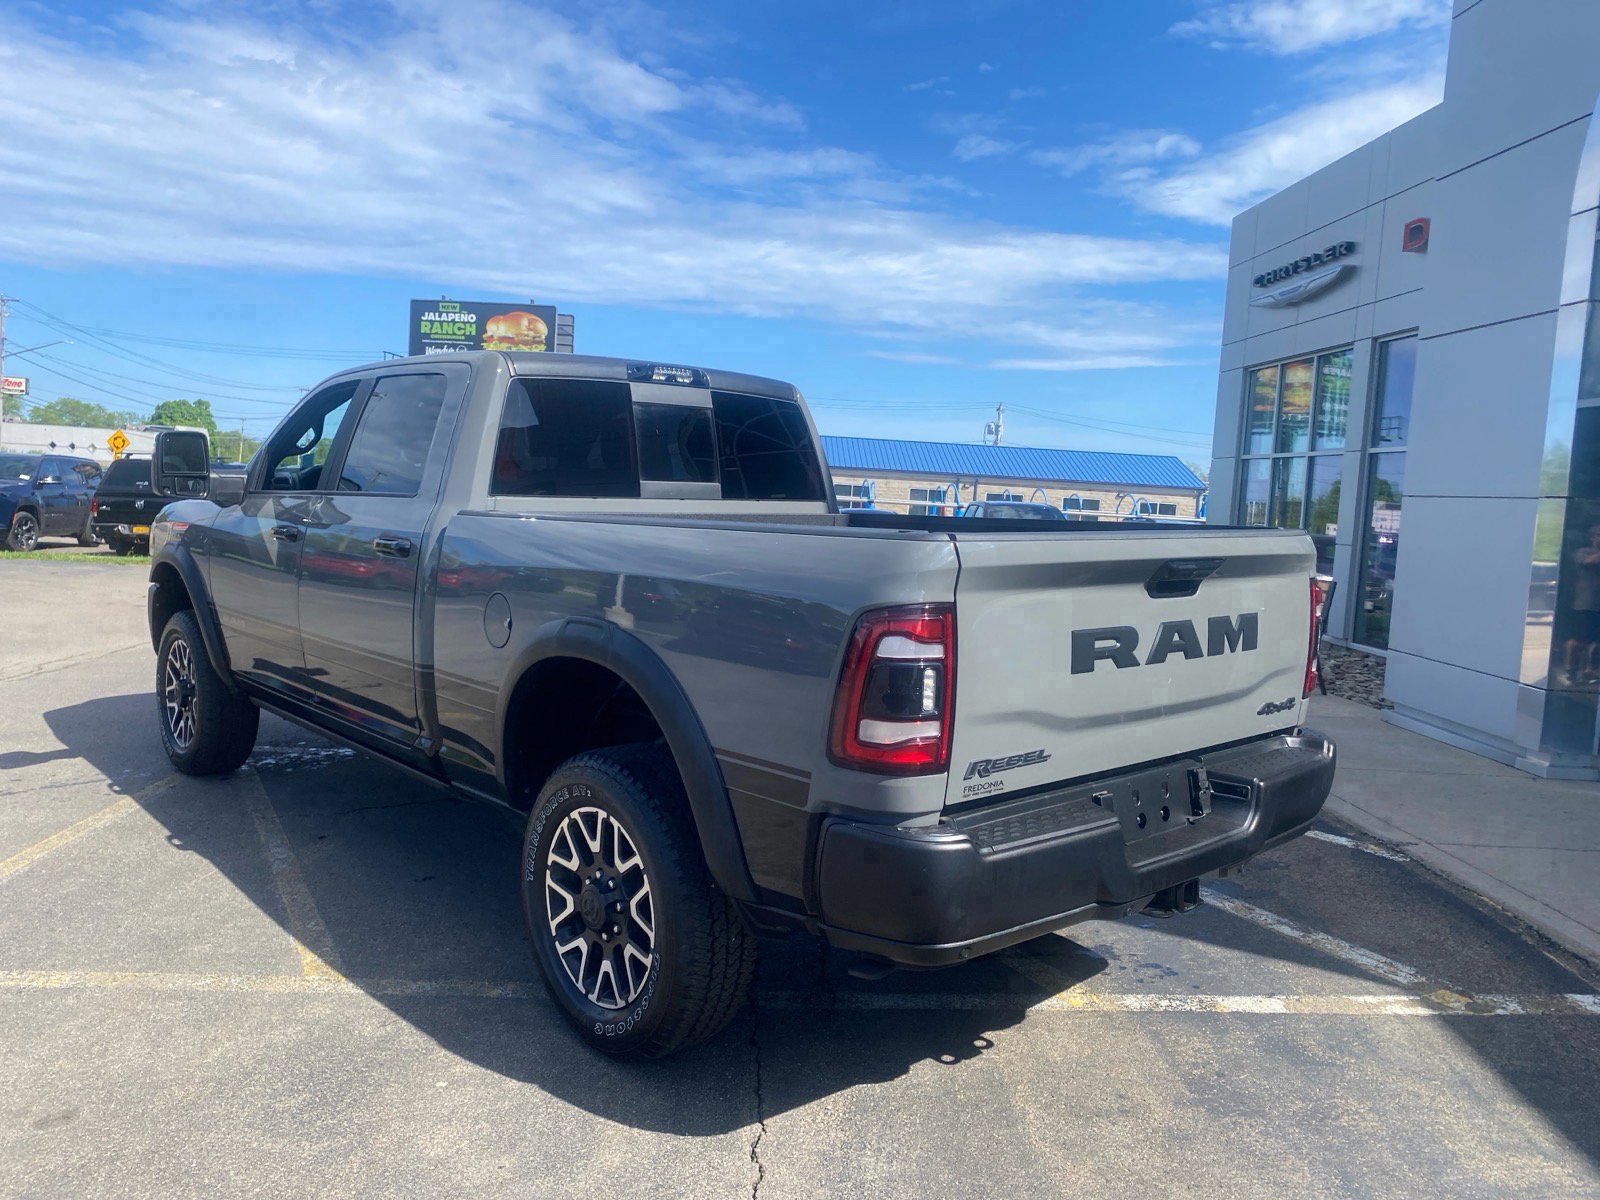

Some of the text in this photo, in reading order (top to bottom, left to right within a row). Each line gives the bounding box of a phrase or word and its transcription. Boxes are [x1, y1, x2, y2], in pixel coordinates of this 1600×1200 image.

[1253, 240, 1356, 288] CHRYSLER
[421, 311, 476, 322] JALAPEÑO
[421, 322, 476, 335] RANCH
[1071, 612, 1258, 675] RAM
[1257, 696, 1296, 715] 4x4
[963, 749, 1052, 781] REBEL
[963, 780, 1004, 793] FREDONIA
[526, 787, 570, 881] TRANSFORCE
